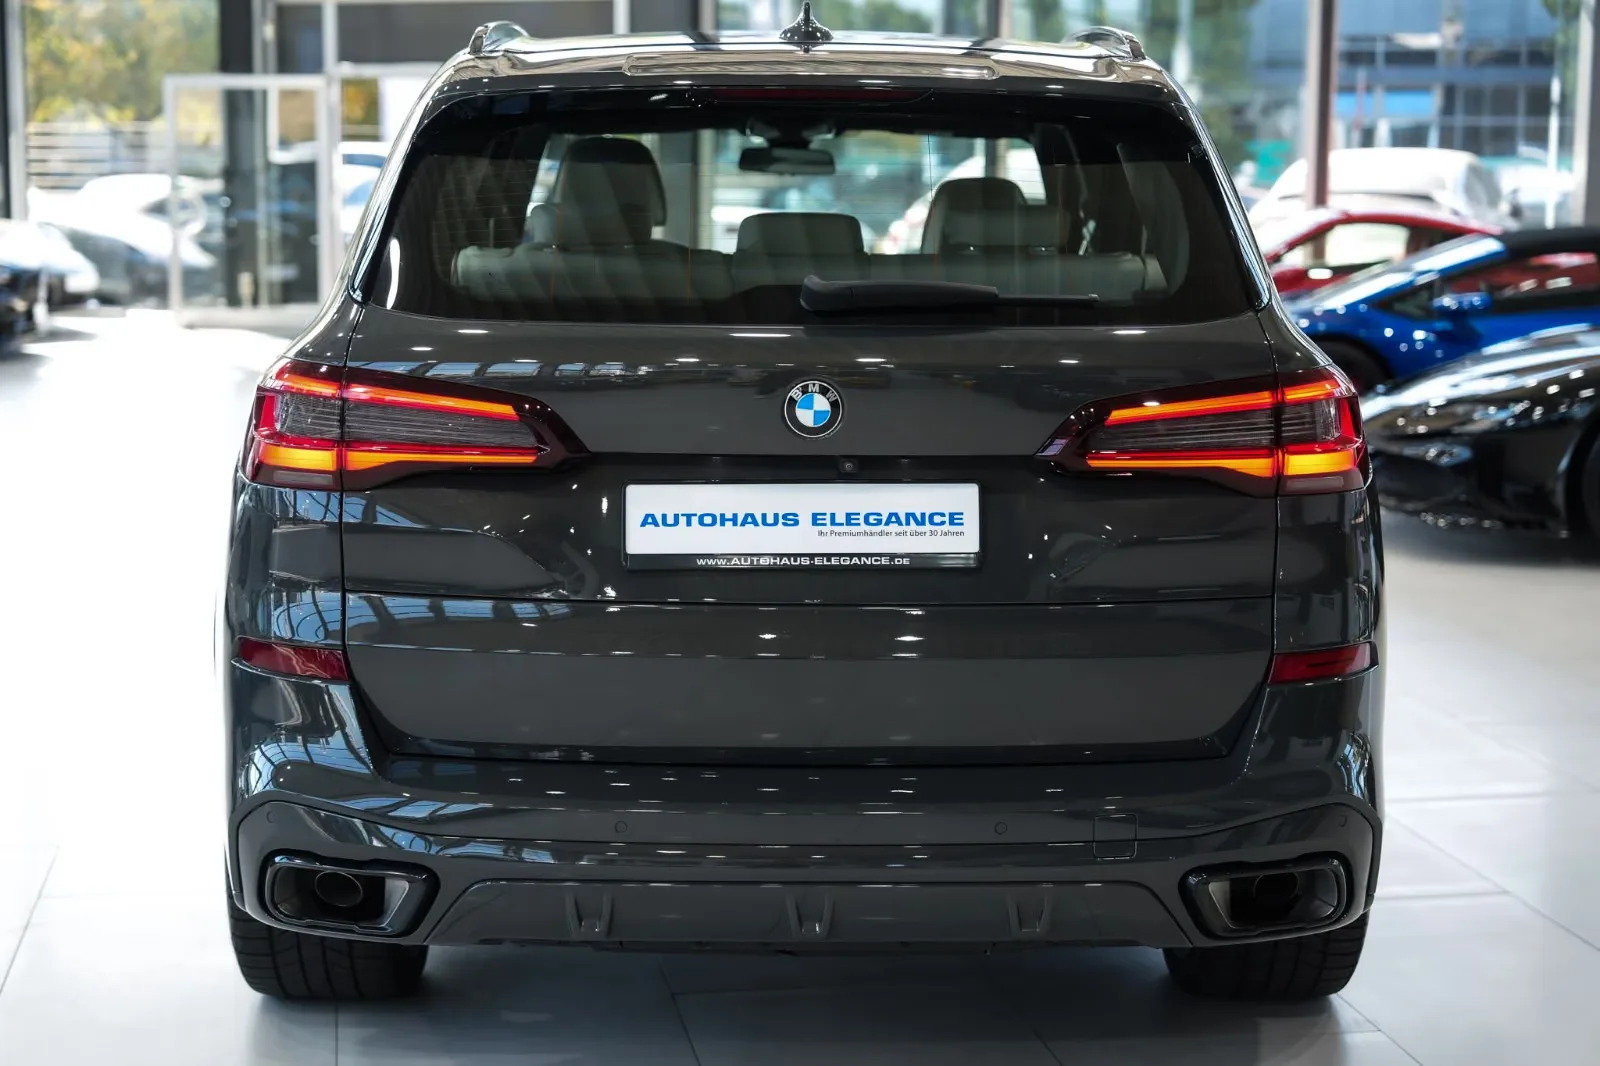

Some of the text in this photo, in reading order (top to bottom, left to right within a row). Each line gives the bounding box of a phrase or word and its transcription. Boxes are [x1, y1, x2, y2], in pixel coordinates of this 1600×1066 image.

[790, 383, 838, 402] BMW
[640, 512, 964, 527] AUTOHAUS ELEGANCE
[817, 529, 965, 537] Ihr Premiumhändler seit über 30 Jahren
